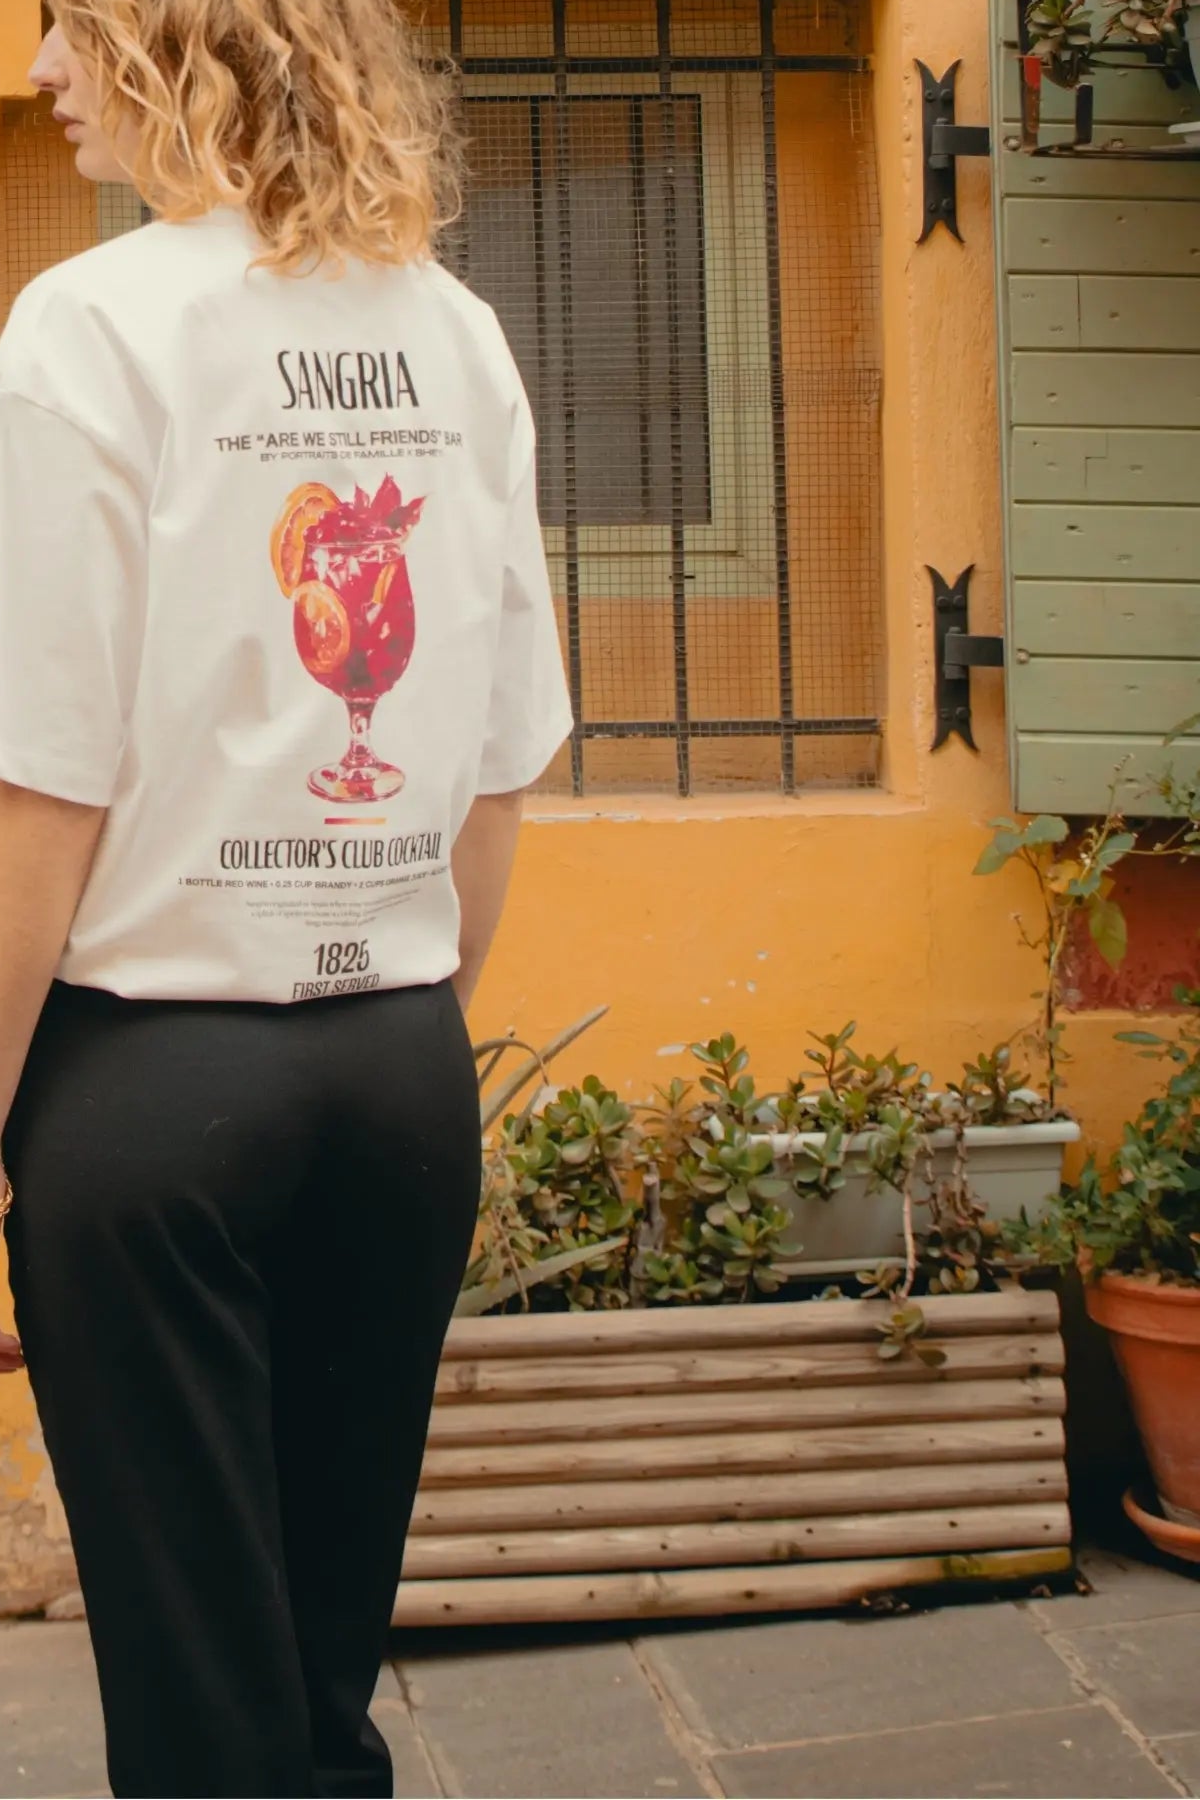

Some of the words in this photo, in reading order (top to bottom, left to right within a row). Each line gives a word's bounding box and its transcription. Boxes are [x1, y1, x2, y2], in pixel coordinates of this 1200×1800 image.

[277, 350, 420, 410] SANGRIA
[215, 434, 252, 451] THE
[256, 432, 299, 448] "ARE
[303, 431, 326, 447] WE
[329, 432, 366, 447] STILL
[370, 429, 442, 446] FRIENDS"
[445, 431, 463, 447] BAR
[260, 452, 278, 462] BY
[354, 448, 405, 459] FAMILLE
[220, 839, 337, 869] COLLECTOR'S
[341, 839, 385, 869] CLUB
[387, 832, 442, 867] COCKTAIL
[185, 878, 223, 888] BOTTLE
[225, 879, 244, 888] RED
[246, 880, 269, 889] WINE
[294, 880, 313, 889] CUP
[315, 880, 352, 890] BRANDY
[313, 939, 370, 975] 1825
[292, 981, 331, 999] FIRST
[332, 973, 380, 994] SERVED
